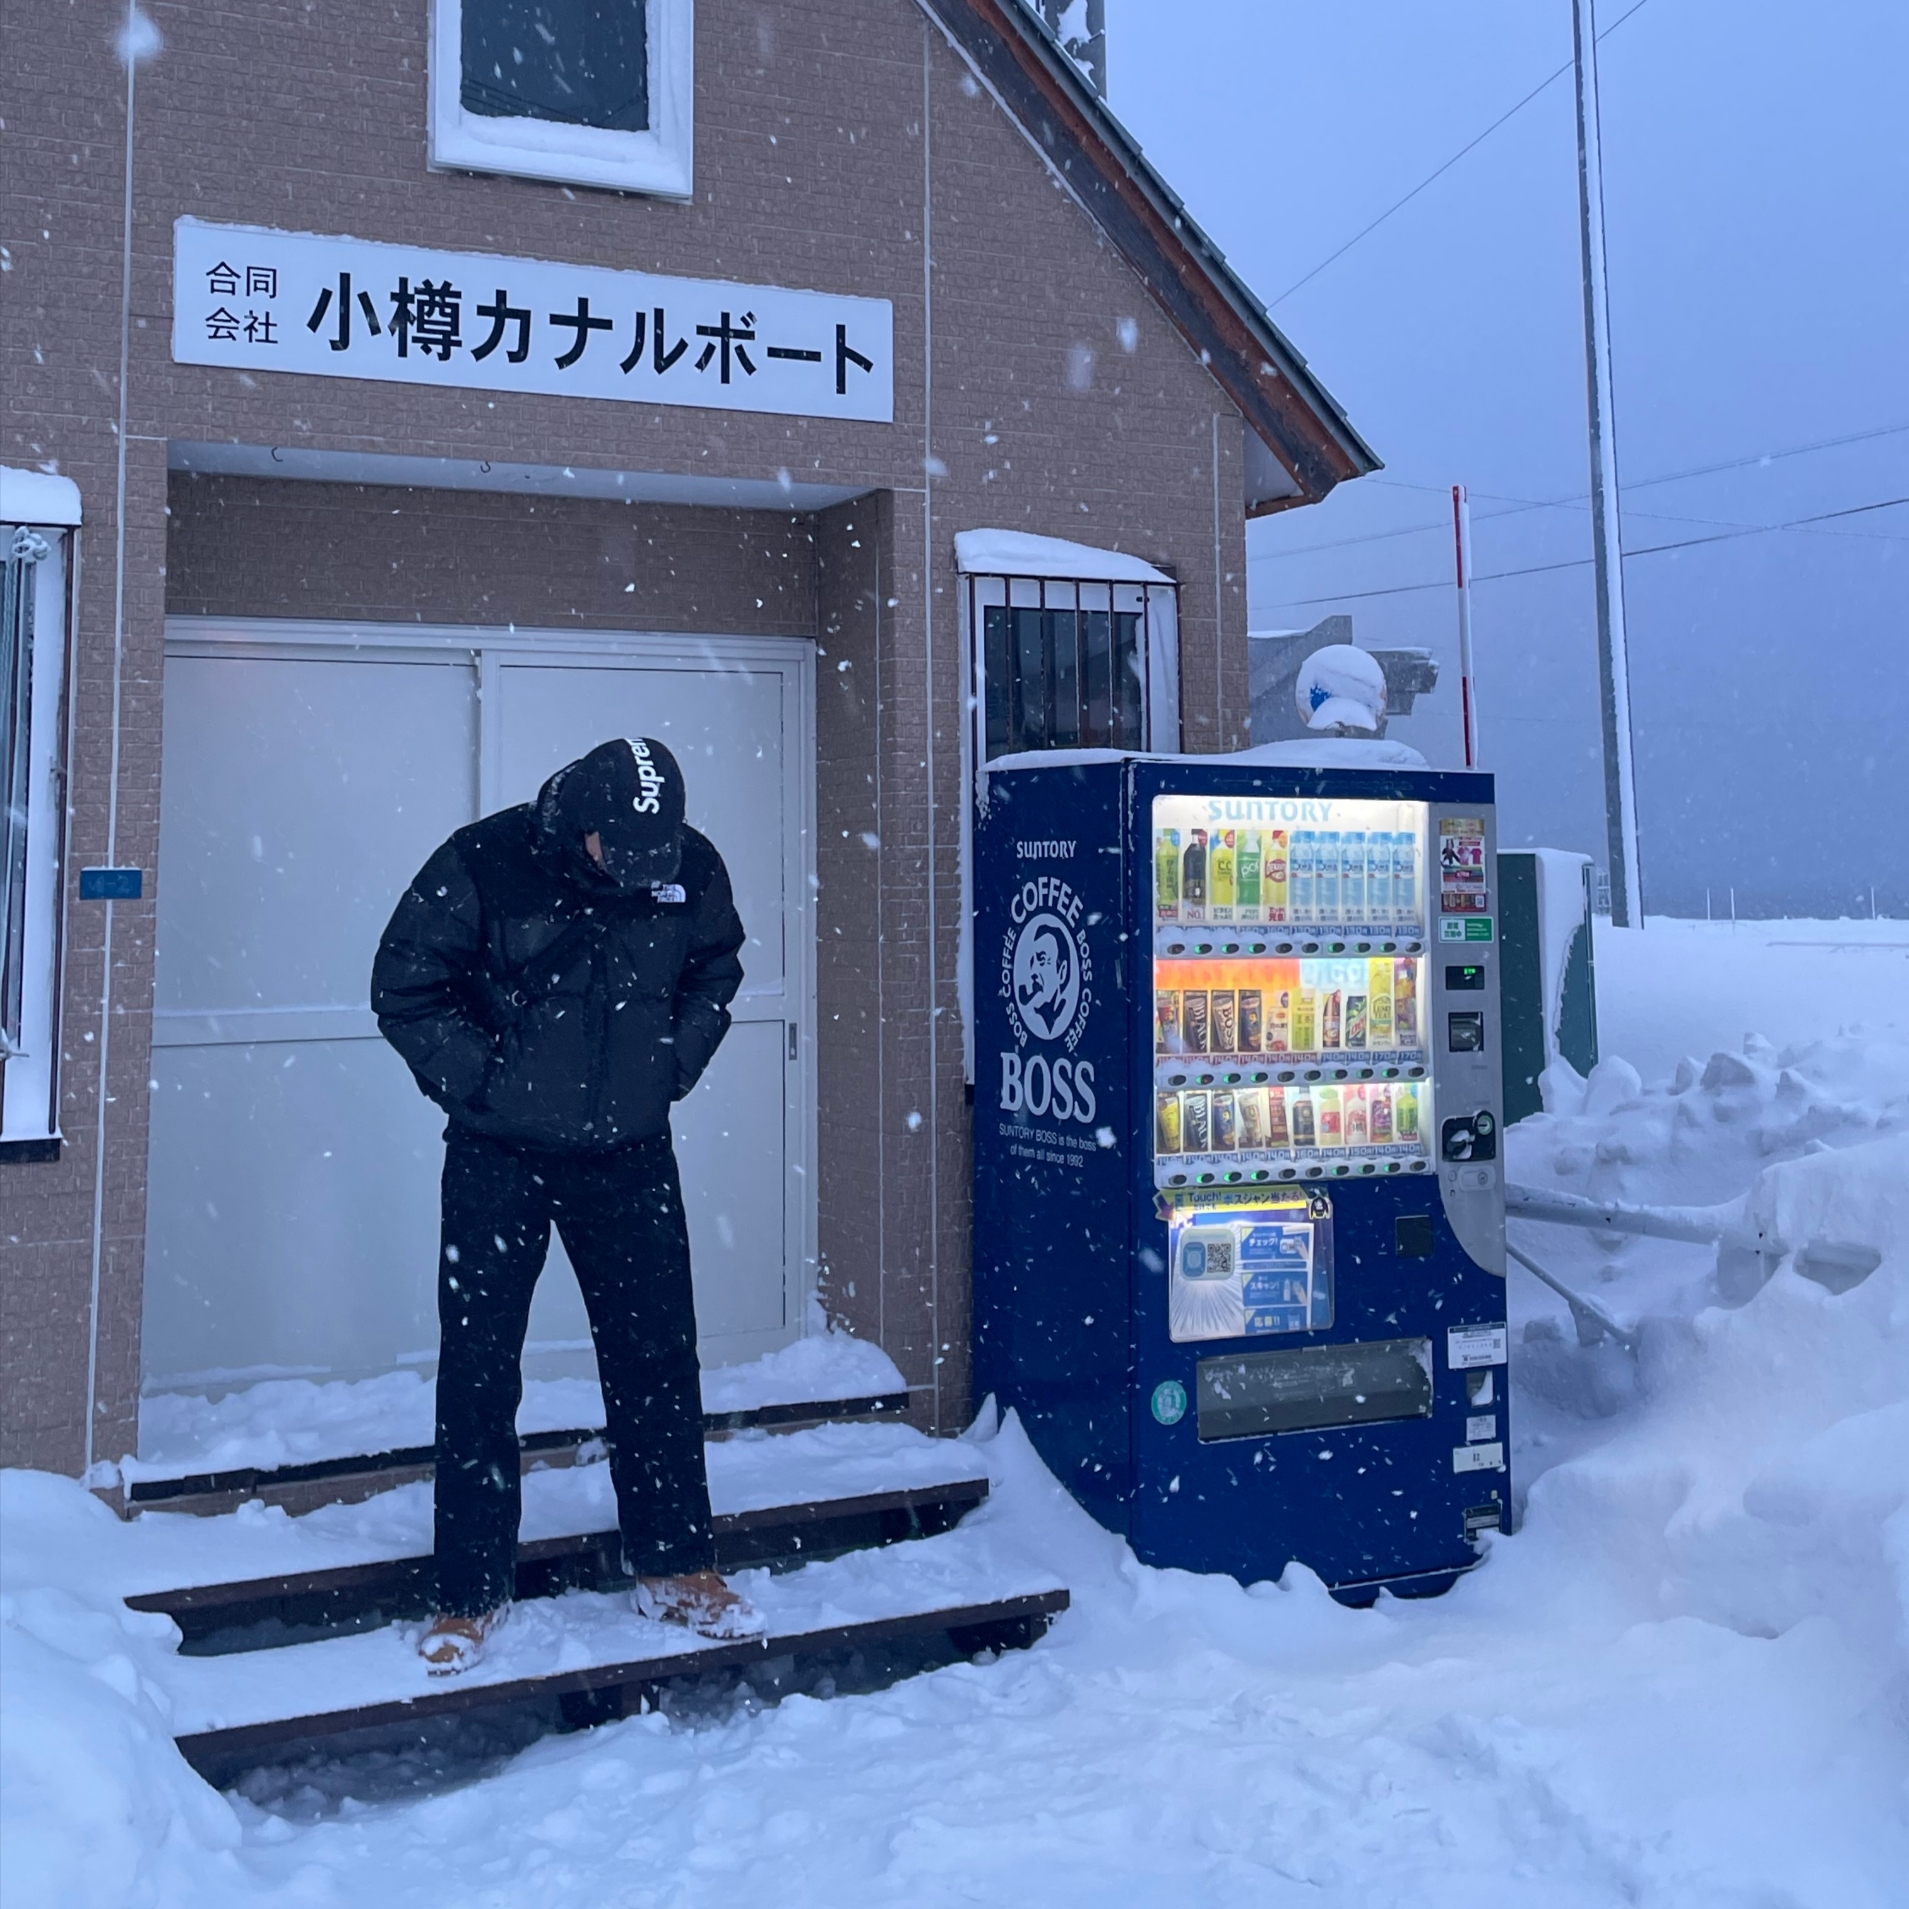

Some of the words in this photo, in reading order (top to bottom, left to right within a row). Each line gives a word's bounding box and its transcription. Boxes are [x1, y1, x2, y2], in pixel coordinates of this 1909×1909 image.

[204, 260, 278, 299] 合同
[204, 308, 278, 345] 会社
[307, 272, 874, 395] 小樽カナルボート
[623, 737, 666, 814] Suprem
[1208, 800, 1333, 822] SUNTORY
[1016, 839, 1077, 859] SUNTORY
[1011, 876, 1084, 928] COFFEE
[1076, 929, 1093, 982] BOSS
[1006, 1002, 1028, 1047] BOSS
[1000, 1051, 1097, 1124] BOSS
[999, 1123, 1034, 1139] SUNTORY
[1035, 1129, 1057, 1145] BOSS
[1058, 1134, 1065, 1146] is
[1066, 1135, 1077, 1148] the
[1079, 1137, 1096, 1151] boss
[1036, 1148, 1045, 1160] all
[1046, 1150, 1065, 1164] since
[1067, 1153, 1084, 1168] 1992
